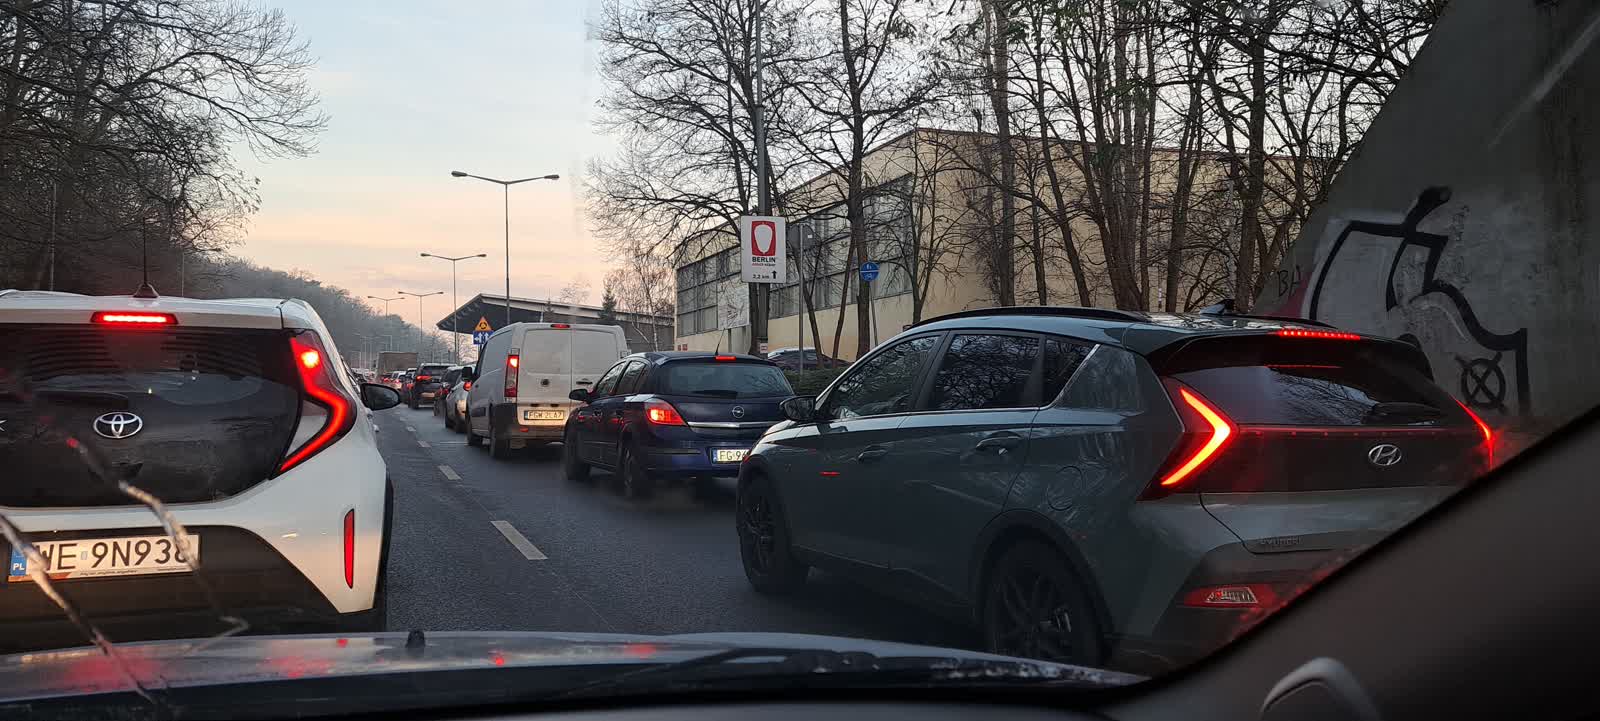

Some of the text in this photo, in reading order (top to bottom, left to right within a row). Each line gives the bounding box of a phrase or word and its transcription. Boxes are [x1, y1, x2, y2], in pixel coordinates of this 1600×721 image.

[719, 450, 733, 461] FG
[34, 542, 78, 571] WE
[13, 562, 25, 571] PL
